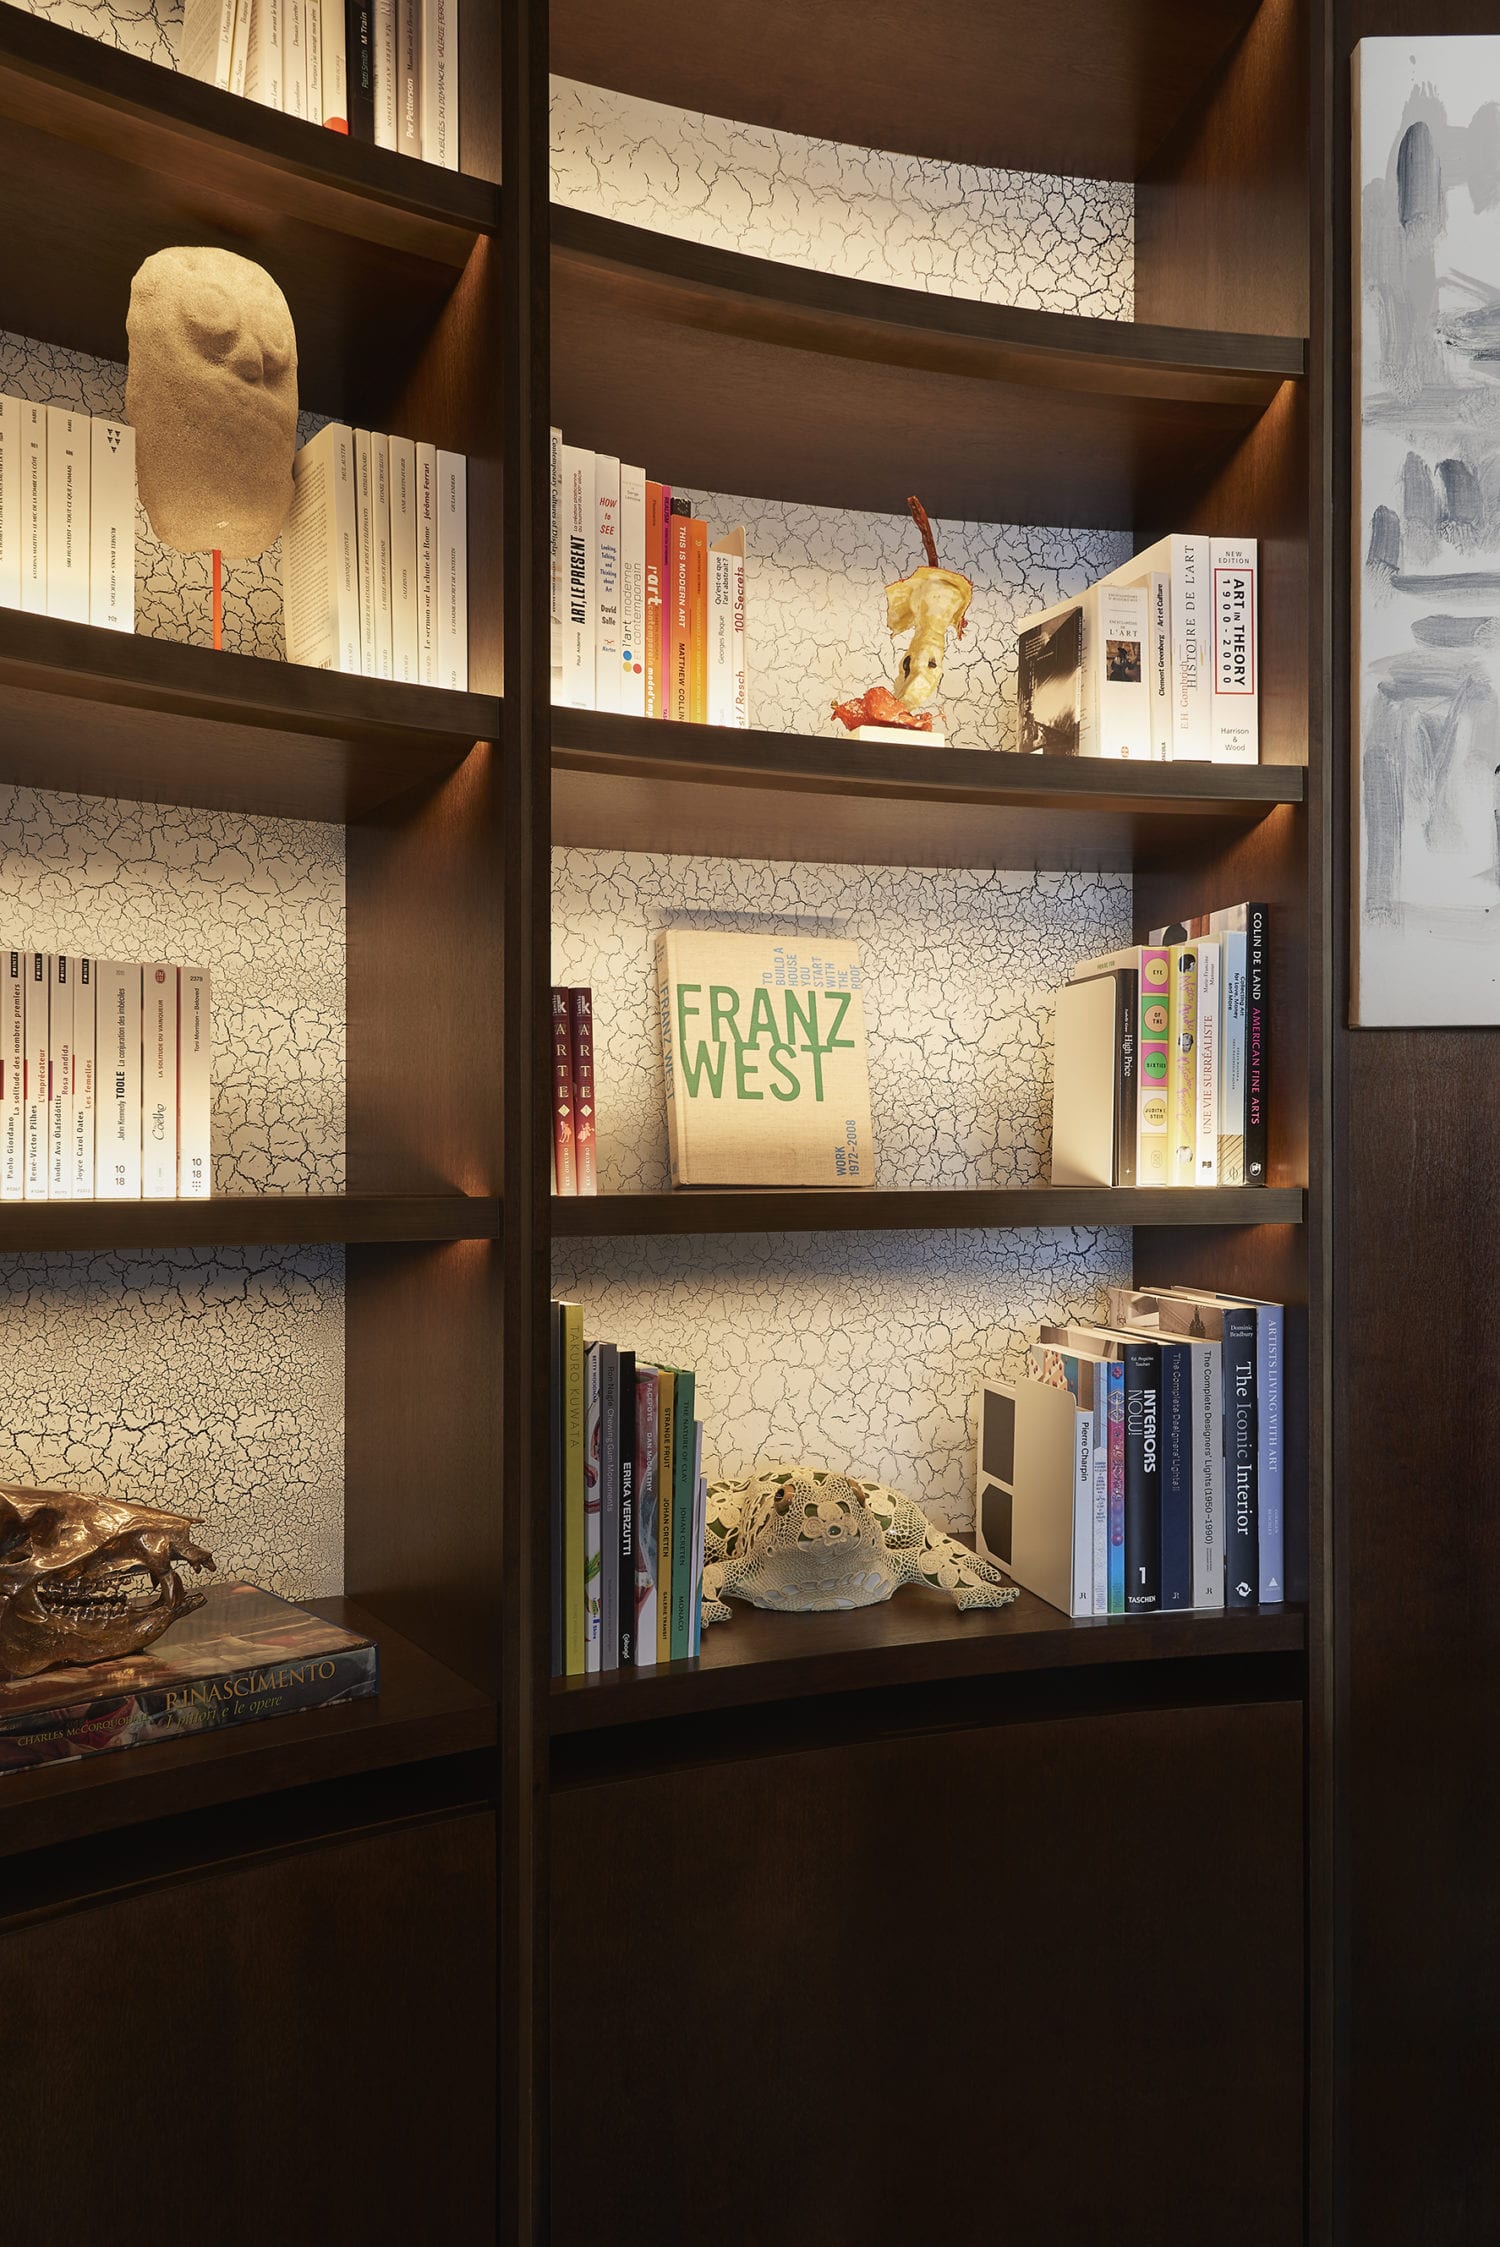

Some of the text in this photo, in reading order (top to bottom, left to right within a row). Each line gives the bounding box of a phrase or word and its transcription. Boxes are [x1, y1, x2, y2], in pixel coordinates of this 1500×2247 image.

[361, 49, 369, 71] Smith
[361, 71, 369, 89] Patti
[437, 61, 446, 105] DIMANCHE
[406, 78, 414, 139] Per Petterson
[423, 491, 432, 521] Jérôme
[599, 497, 617, 508] HOW
[604, 512, 611, 521] to
[599, 524, 615, 536] SEE
[423, 550, 430, 560] de
[678, 526, 686, 628] THIS IS MODERN ART
[600, 604, 617, 615] David
[622, 562, 632, 648] l'art moderne
[633, 562, 644, 645] contemporain
[734, 567, 745, 634] 100 Secrets
[1184, 544, 1197, 690] HISTOIRE DE L'ART
[601, 617, 616, 627] Salle
[1233, 578, 1246, 686] ART THEORY
[424, 638, 431, 650] Le
[717, 636, 726, 665] Georges
[1156, 583, 1166, 697] Clement Greenberg Culture
[678, 642, 687, 686] MATTHEW
[735, 671, 745, 705] Resch
[1179, 660, 1190, 708] Gombrich
[1220, 727, 1249, 735] Harrison
[1224, 744, 1246, 752] Wood
[762, 972, 773, 985] TO
[775, 956, 786, 986] BUILD
[787, 954, 798, 987] HOUSE
[800, 966, 810, 987] YOU
[812, 956, 823, 987] START
[825, 962, 836, 988] WITH
[838, 970, 849, 989] THE
[849, 964, 861, 990] ROOF
[13, 984, 22, 1018] premiers
[677, 983, 855, 1048] FRANZ
[1251, 912, 1262, 1125] COLIN DE LAND AMERICAN FINE ARTS
[660, 986, 674, 1100] FRANZ WEST
[1122, 1034, 1133, 1077] High Price
[38, 1048, 47, 1103] L'imprécateur
[61, 1044, 69, 1095] Rosa candida
[84, 1059, 92, 1093] femelles
[115, 1027, 127, 1125] Kennedy TOOLE conjuration
[680, 1040, 833, 1102] WEST
[1202, 1015, 1213, 1135] UNE VIE SURRÉALISTE
[12, 1073, 20, 1104] solitude
[13, 1106, 20, 1116] La
[6, 1116, 14, 1154] Giordano
[29, 1105, 38, 1182] René-Victor Pilhes
[76, 1110, 85, 1181] Joyce Carol Oates
[6, 1157, 14, 1179] Paolo
[115, 1164, 126, 1174] 10
[192, 1158, 202, 1167] 10
[192, 1169, 202, 1178] 18
[835, 1146, 847, 1176] WORK
[115, 1176, 126, 1186] 18
[569, 1325, 580, 1449] TAKURO KUWATA
[1268, 1319, 1278, 1473] ARTISTS LIVING WITH ART
[663, 1407, 671, 1444] STRANGE
[1127, 1389, 1142, 1436] NOW!
[1170, 1353, 1181, 1485] The Complete Lights
[1202, 1350, 1213, 1487] The Complete Designers' Lights
[605, 1366, 615, 1512] Ron Nagle Chewing Gum Monuments
[1143, 1389, 1156, 1473] INTERIORS
[662, 1445, 670, 1468] FRUIT
[1079, 1421, 1089, 1482] Pierre Charpin
[1236, 1361, 1253, 1536] The Iconic Interior
[622, 1462, 632, 1556] ERIKA VERZUTTI
[677, 1400, 690, 1632] THE NATURE OF CLAY JOHAN CRETEN MONACO
[1139, 1567, 1146, 1584] 1
[1128, 1596, 1156, 1604] TASCHEN
[165, 1660, 336, 1711] RINASCIMENTO
[249, 1695, 283, 1715] opere
[17, 1730, 64, 1747] CHARLES
